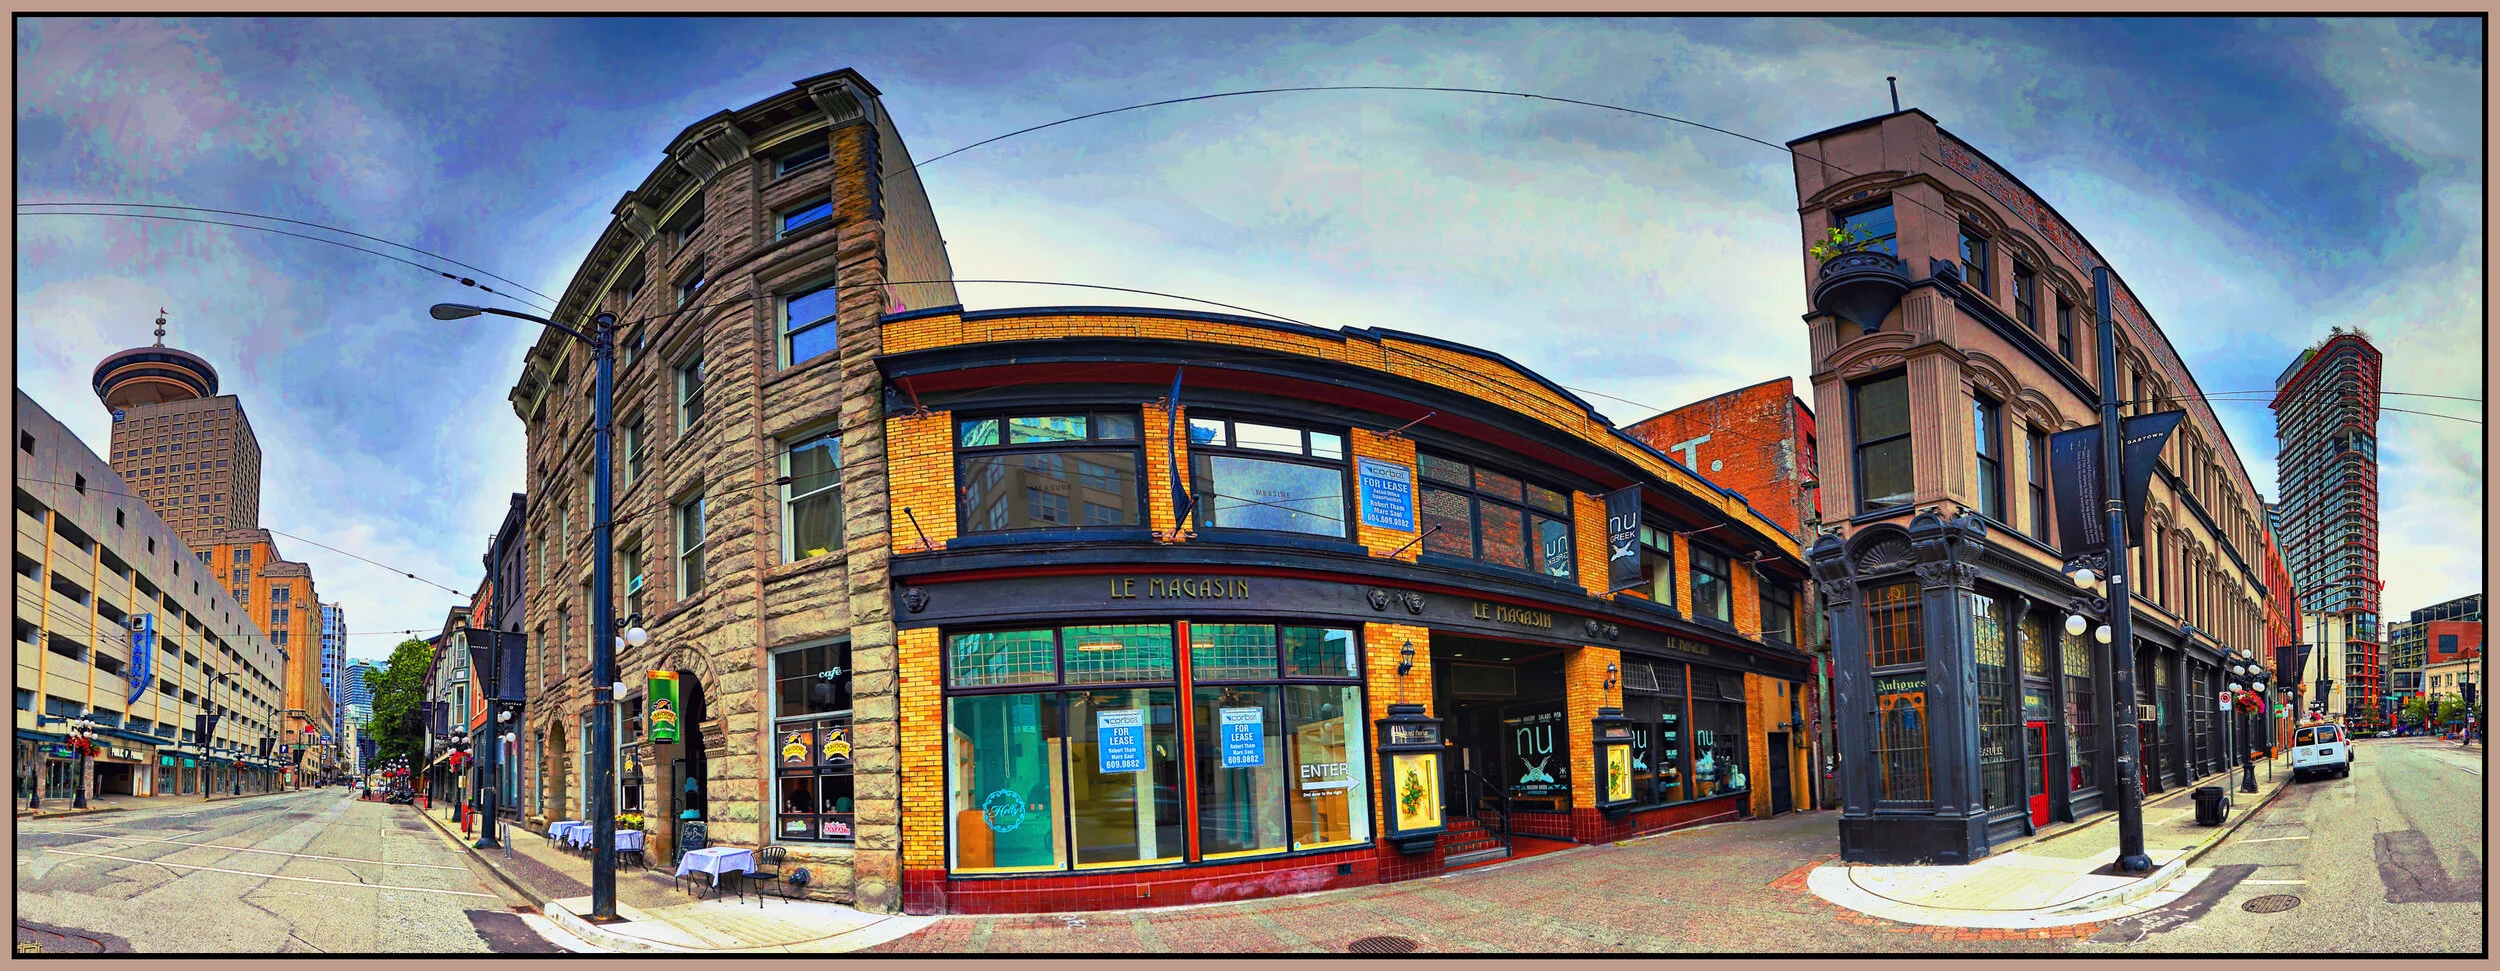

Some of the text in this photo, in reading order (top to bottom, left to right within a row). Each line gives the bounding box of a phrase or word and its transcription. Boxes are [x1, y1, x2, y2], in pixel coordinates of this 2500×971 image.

[2127, 432, 2164, 445] GASTOWN
[1372, 467, 1405, 479] corbel
[1364, 477, 1409, 493] FOR LEASE
[1369, 500, 1389, 509] Robert
[1609, 511, 1636, 535] nu
[1610, 530, 1636, 543] GREEK
[1110, 578, 1249, 599] LE MAGASIN
[1473, 602, 1552, 629] LE MAGASIN
[1667, 635, 1677, 649] LE
[132, 633, 142, 677] PARK
[818, 666, 842, 680] café
[1878, 679, 1927, 693] Antiques
[1109, 716, 1138, 725] corbel
[1231, 713, 1258, 722] corbel
[1113, 727, 1129, 737] FOR
[1235, 724, 1249, 733] FOR
[1109, 736, 1134, 746] LEASE
[1231, 732, 1254, 742] LEASE
[1516, 725, 1553, 756] nu
[1697, 729, 1715, 746] nu
[1106, 759, 1140, 769] 609.0882
[1227, 754, 1259, 764] 609.0882
[1301, 763, 1348, 778] ENTER
